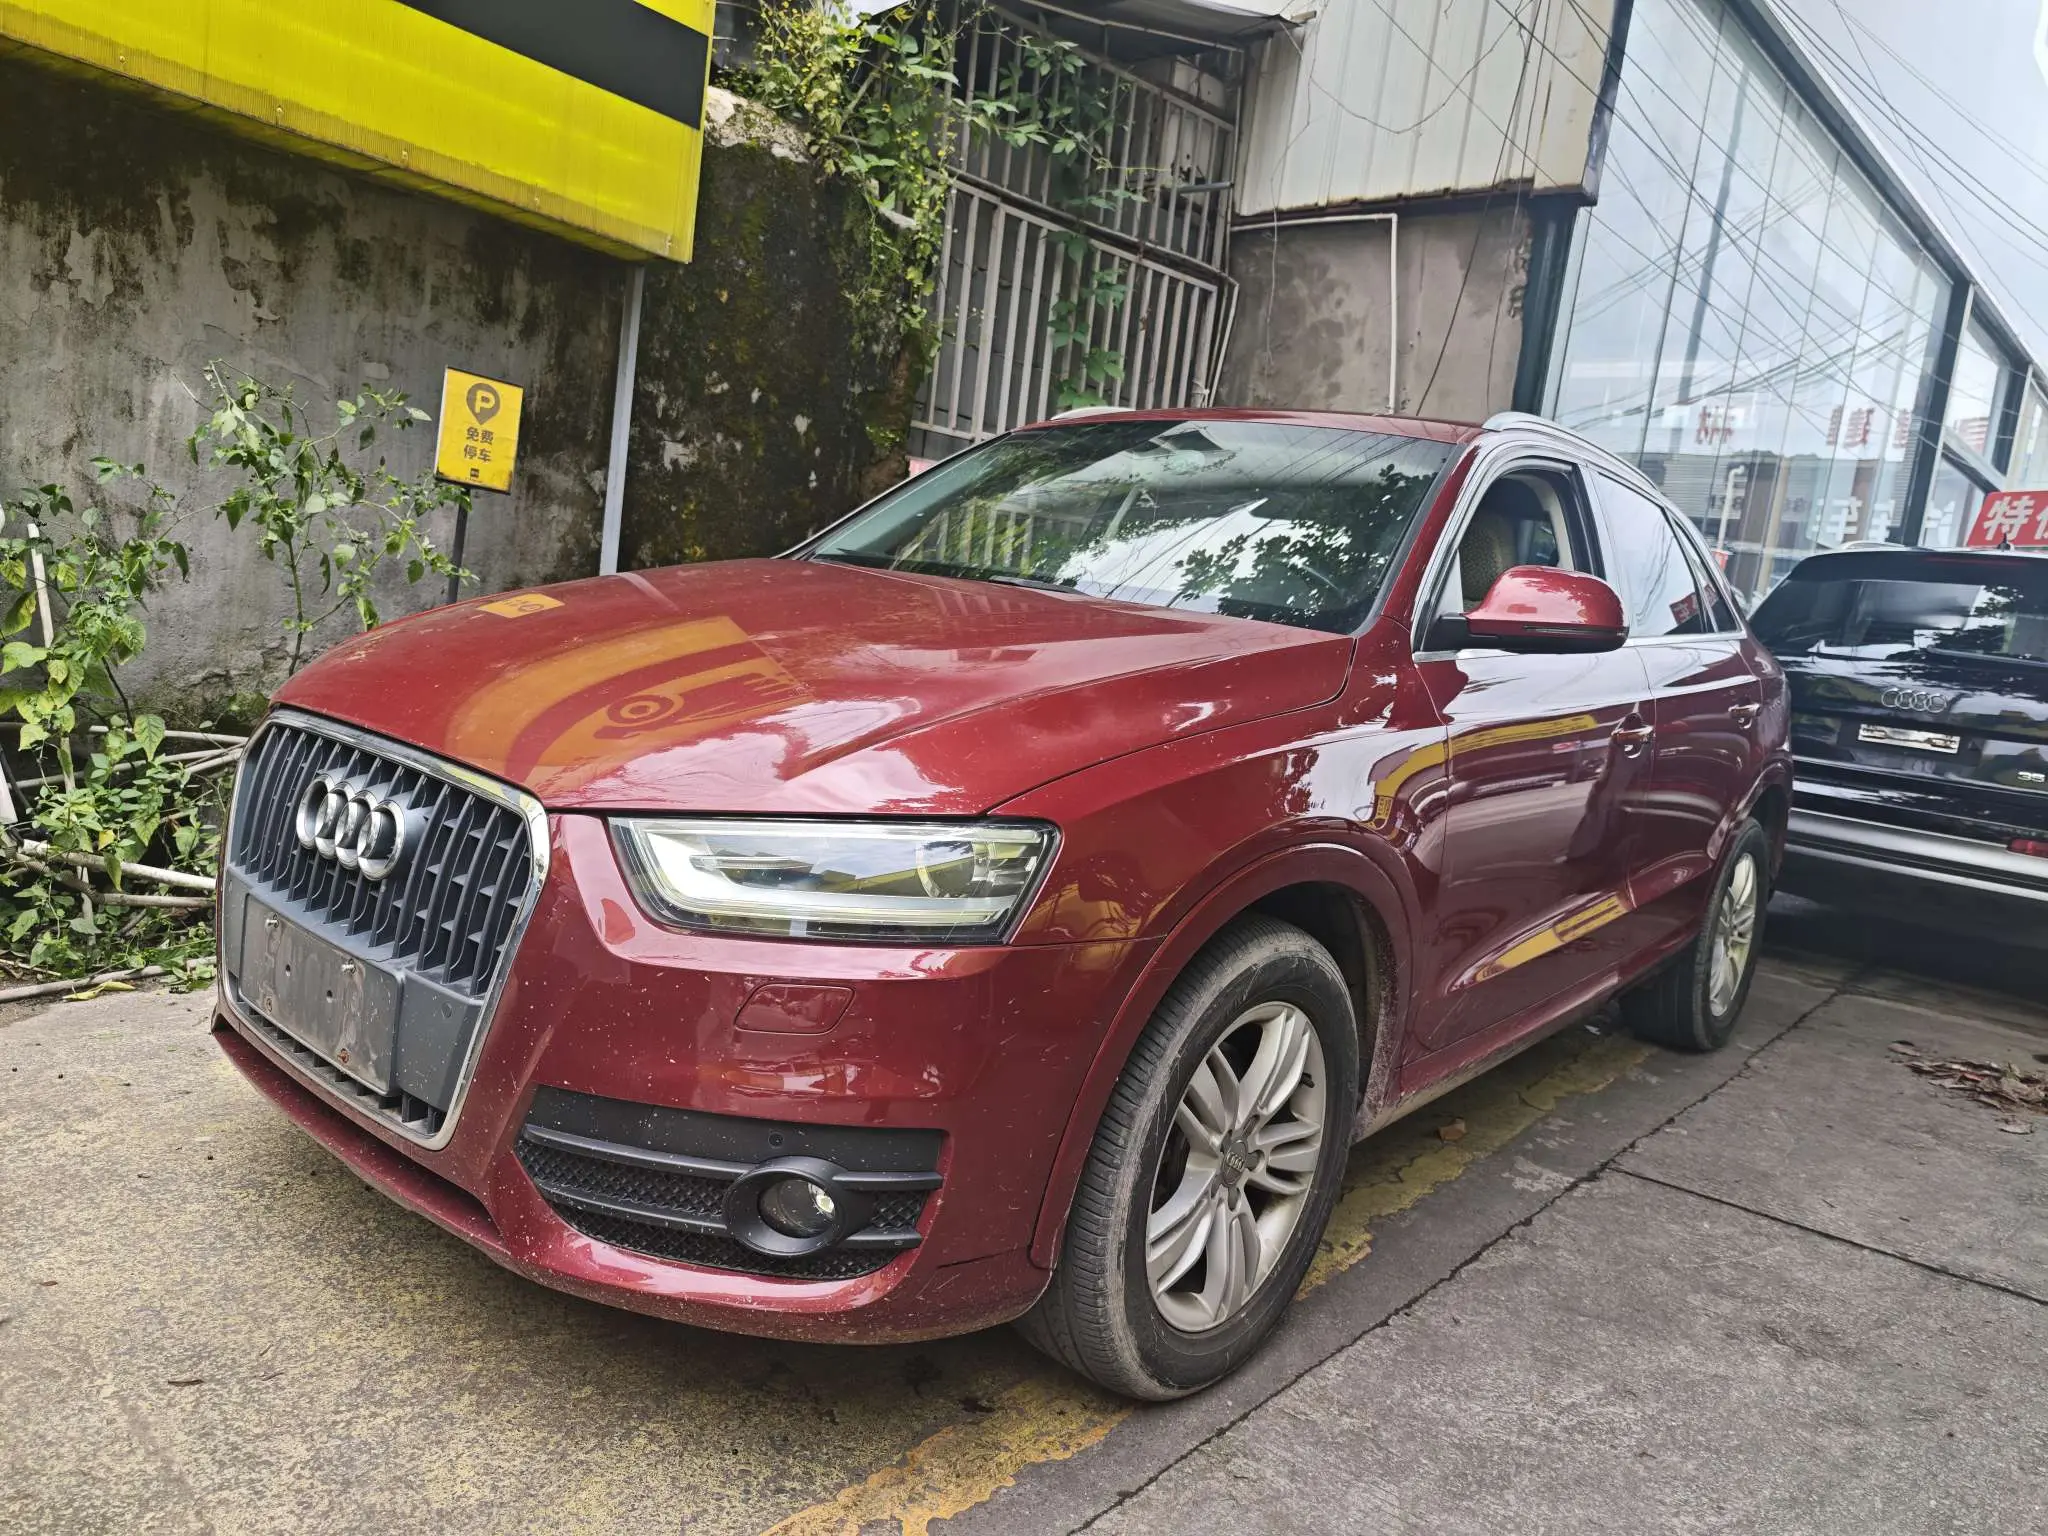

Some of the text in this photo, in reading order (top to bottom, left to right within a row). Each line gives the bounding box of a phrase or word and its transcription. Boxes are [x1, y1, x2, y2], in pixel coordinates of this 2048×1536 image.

[475, 390, 496, 413] P
[466, 427, 494, 445] 免费
[463, 444, 491, 463] 停车
